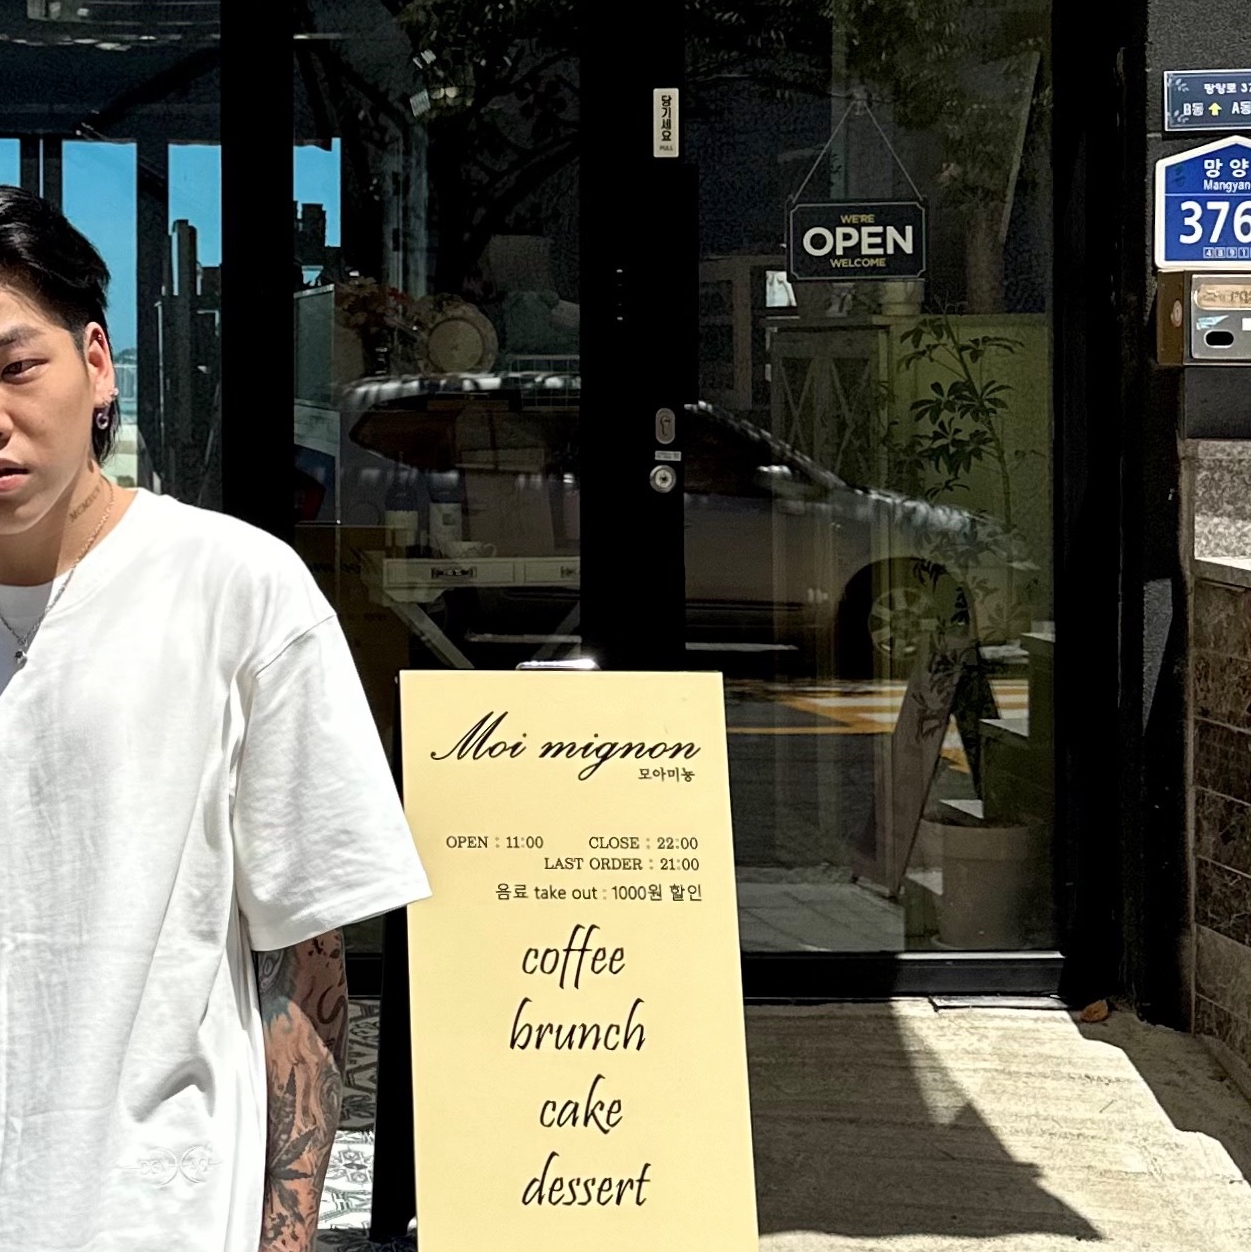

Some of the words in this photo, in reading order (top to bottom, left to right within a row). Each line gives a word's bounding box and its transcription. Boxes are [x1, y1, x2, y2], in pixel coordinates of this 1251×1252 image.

[1240, 82, 1251, 93] 3
[661, 95, 673, 141] 당기세요
[1183, 102, 1204, 116] B동
[1179, 200, 1251, 245] 376
[802, 225, 914, 257] OPEN
[829, 257, 887, 268] WELCOME
[430, 711, 528, 761] Moi
[538, 733, 701, 782] mignon
[446, 835, 489, 849] OPEN
[506, 835, 544, 850] 11:00
[588, 836, 640, 850] CLOSE
[657, 836, 699, 850] 22:00
[543, 857, 585, 871] LAST
[589, 857, 644, 871] ORDER
[659, 857, 700, 871] 21:00
[495, 882, 529, 901] 음료
[534, 884, 567, 900] take
[571, 886, 598, 900] out
[611, 883, 663, 902] 1000원
[669, 882, 703, 902] 할인
[521, 923, 626, 990] coffee
[509, 996, 646, 1052] brunch
[539, 1073, 623, 1135] cake
[521, 1151, 652, 1207] dessert
